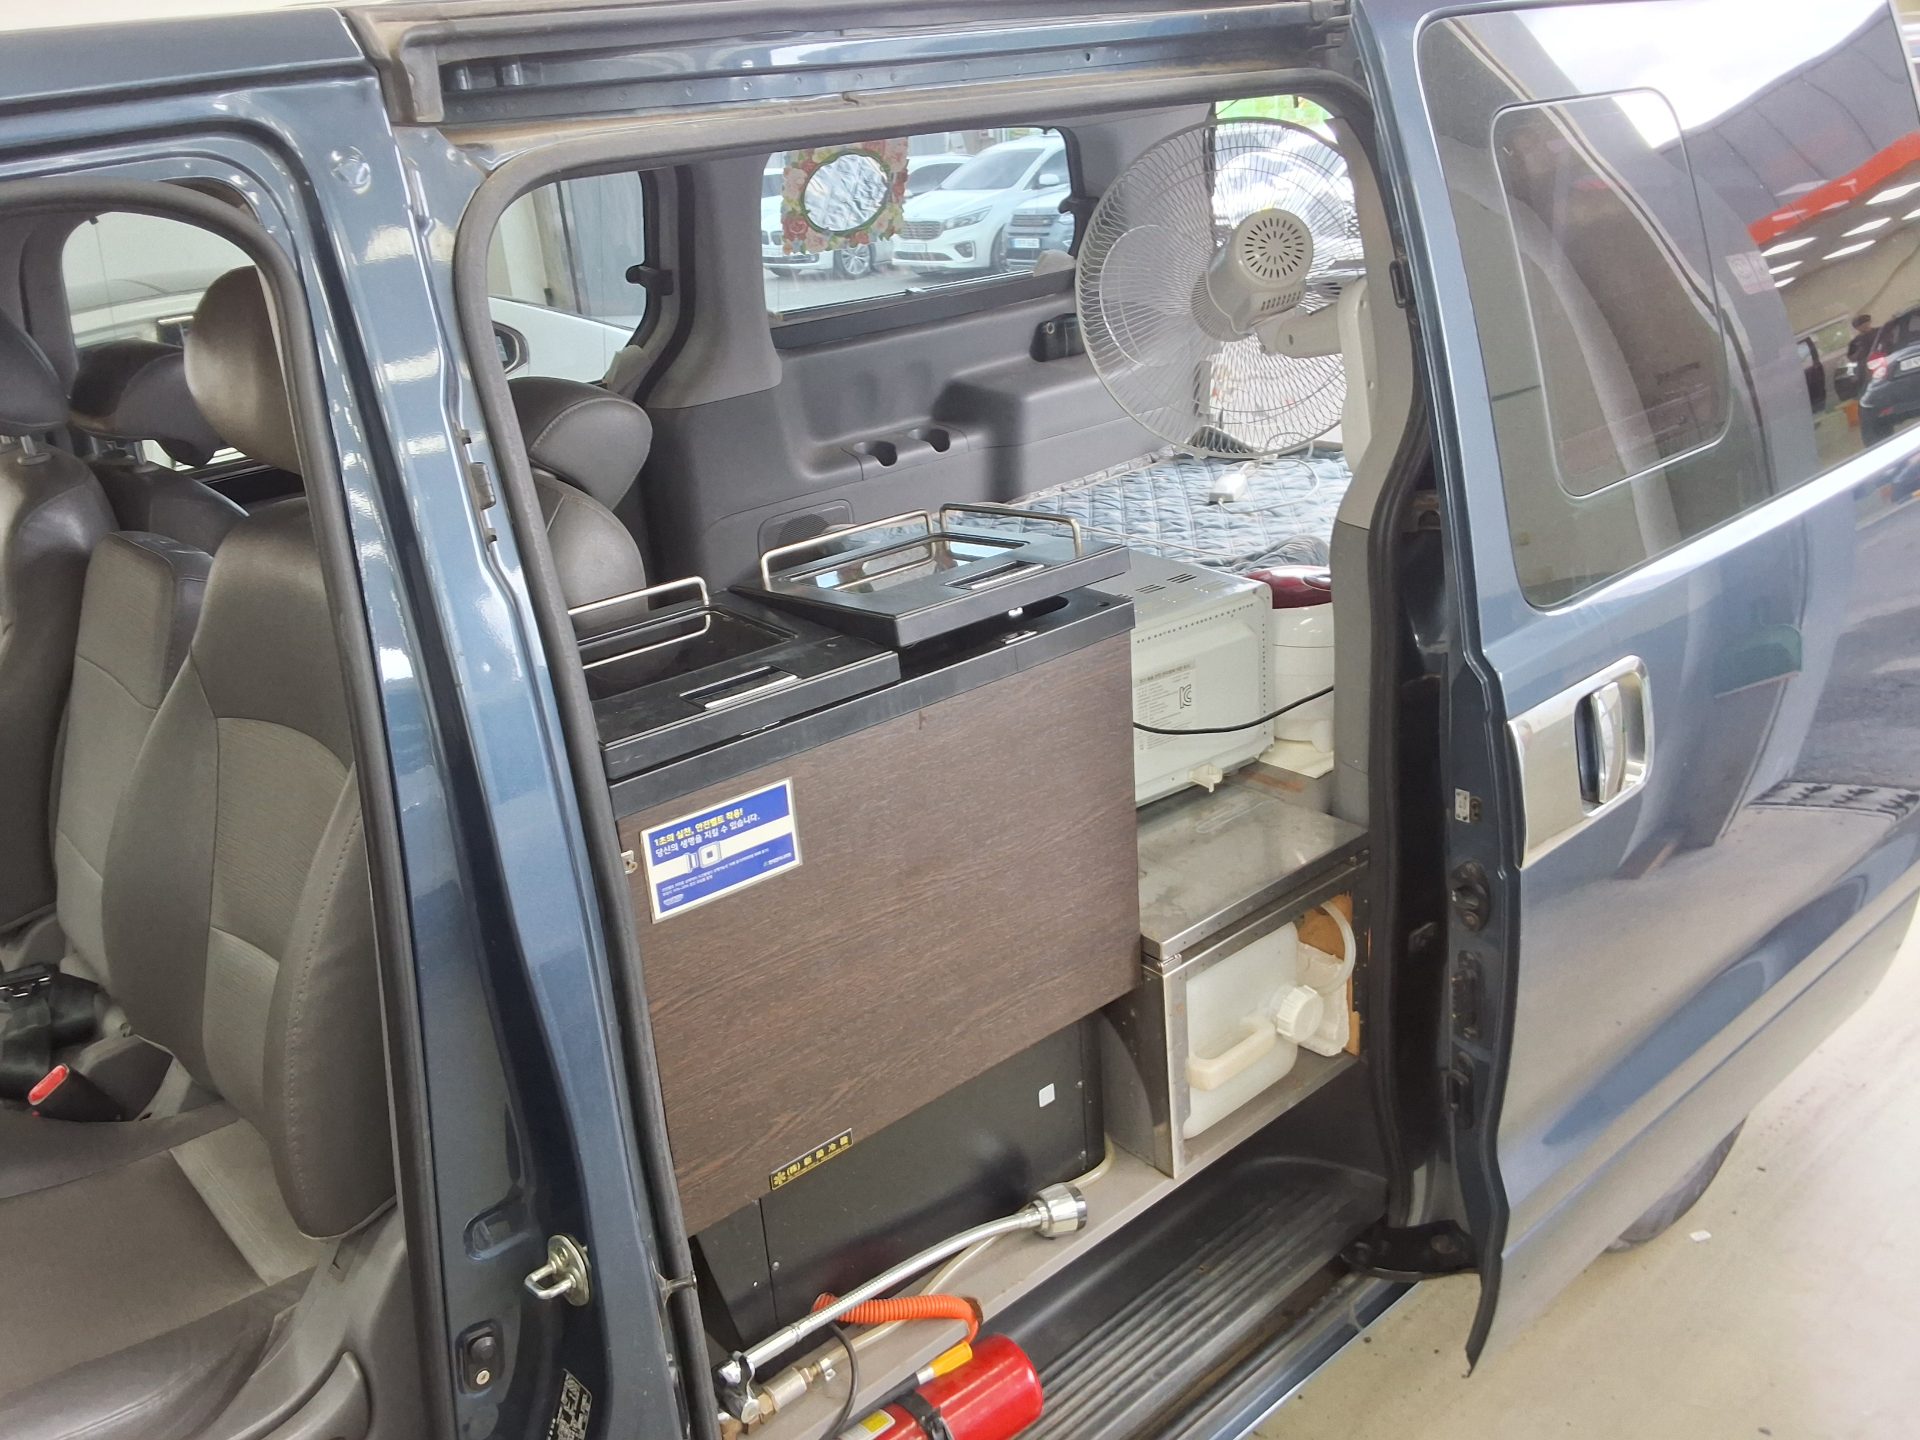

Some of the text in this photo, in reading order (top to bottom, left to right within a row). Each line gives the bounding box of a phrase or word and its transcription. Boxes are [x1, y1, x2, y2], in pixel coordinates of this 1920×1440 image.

[655, 813, 761, 858] 당신의 생명을 지킬 수 있습니다.
